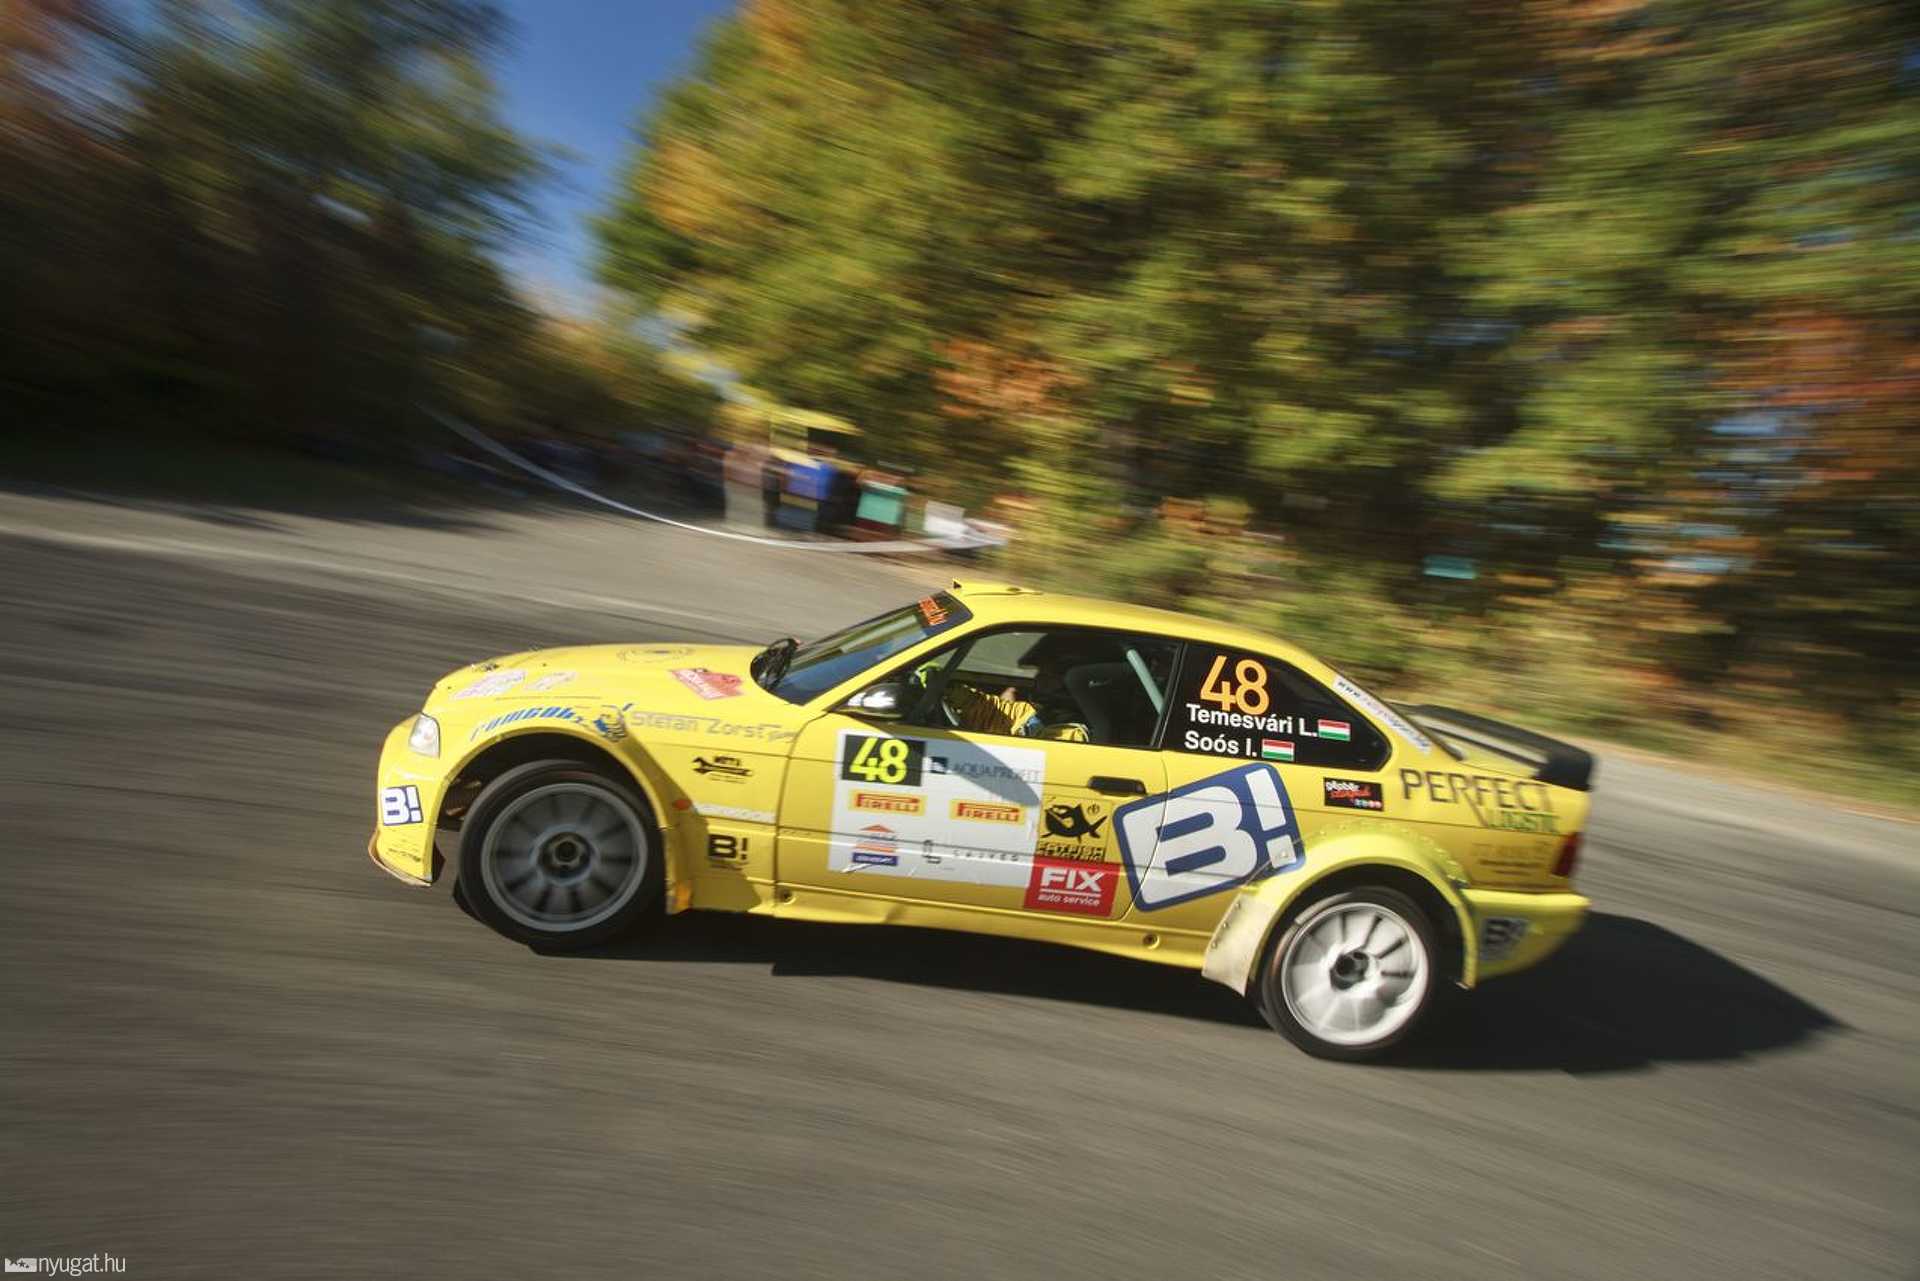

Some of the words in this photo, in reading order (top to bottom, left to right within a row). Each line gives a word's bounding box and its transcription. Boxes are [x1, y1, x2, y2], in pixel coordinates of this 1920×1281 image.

[1200, 655, 1270, 716] 48
[1186, 703, 1293, 734] Temesvári
[1299, 718, 1318, 737] L.
[1184, 730, 1239, 755] Soós
[1246, 738, 1257, 757] I.
[849, 737, 909, 784] 48
[382, 785, 422, 824] B!
[856, 793, 921, 814] PIRELLI
[957, 802, 1021, 823] PIRELLI
[1400, 767, 1553, 828] PERFECT
[708, 833, 749, 860] B!
[1122, 768, 1297, 904] B!
[1041, 867, 1104, 892] FIX
[1063, 895, 1100, 907] service
